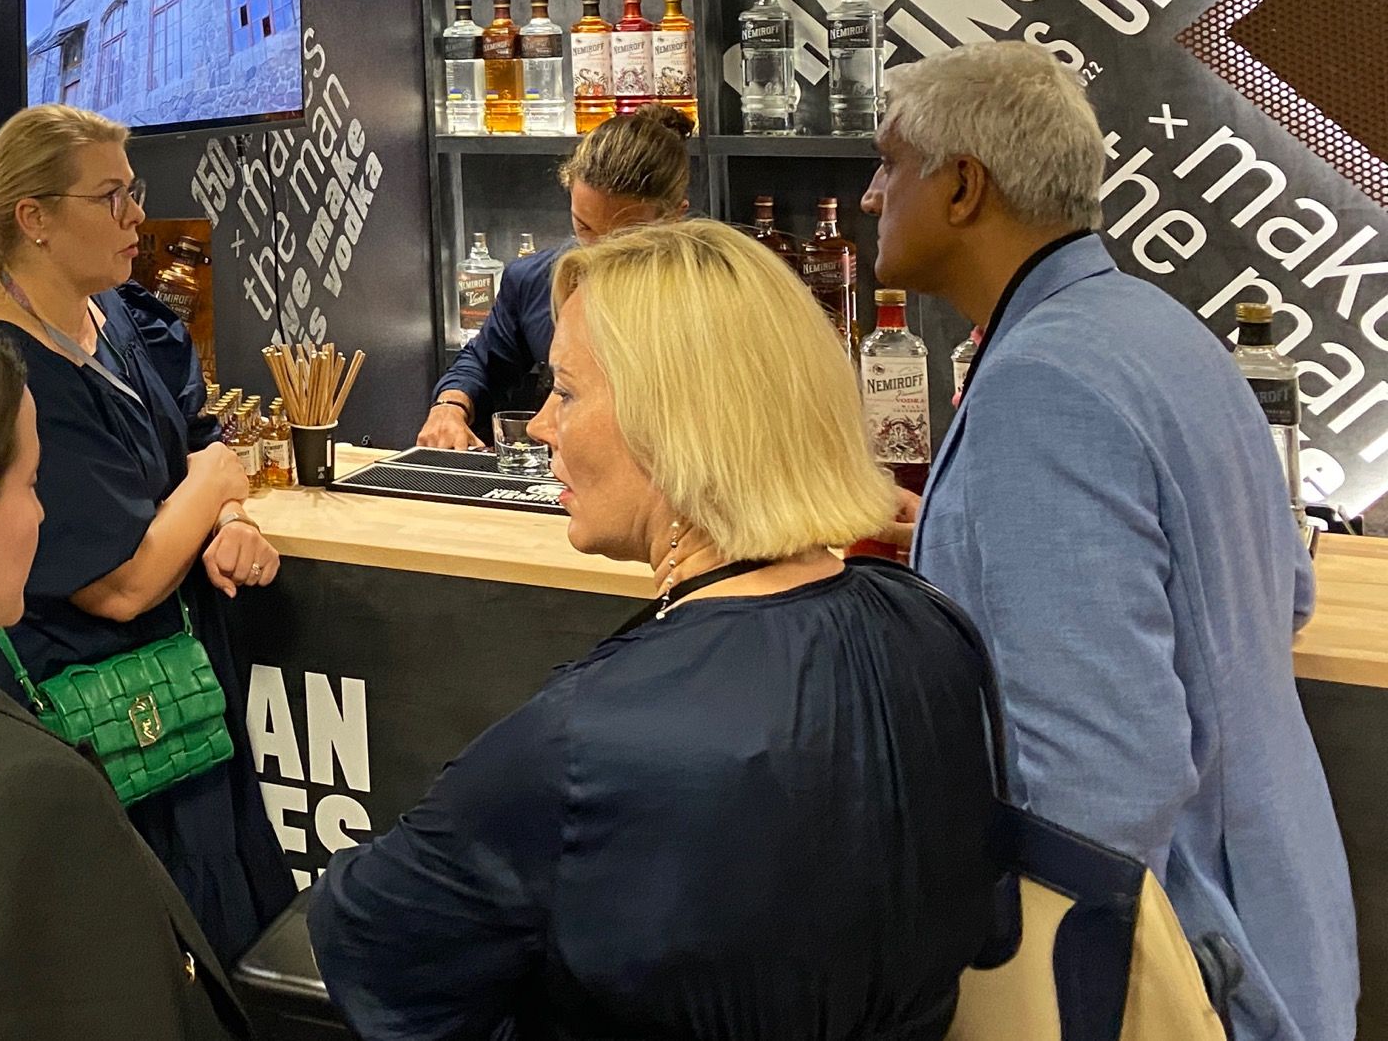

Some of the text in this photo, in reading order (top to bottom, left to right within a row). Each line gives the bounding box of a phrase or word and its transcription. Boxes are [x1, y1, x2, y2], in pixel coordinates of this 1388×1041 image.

[191, 138, 236, 230] 150
[289, 73, 351, 215] man
[306, 118, 366, 269] make
[323, 151, 383, 298] vodka
[867, 373, 924, 394] NEMIROFF
